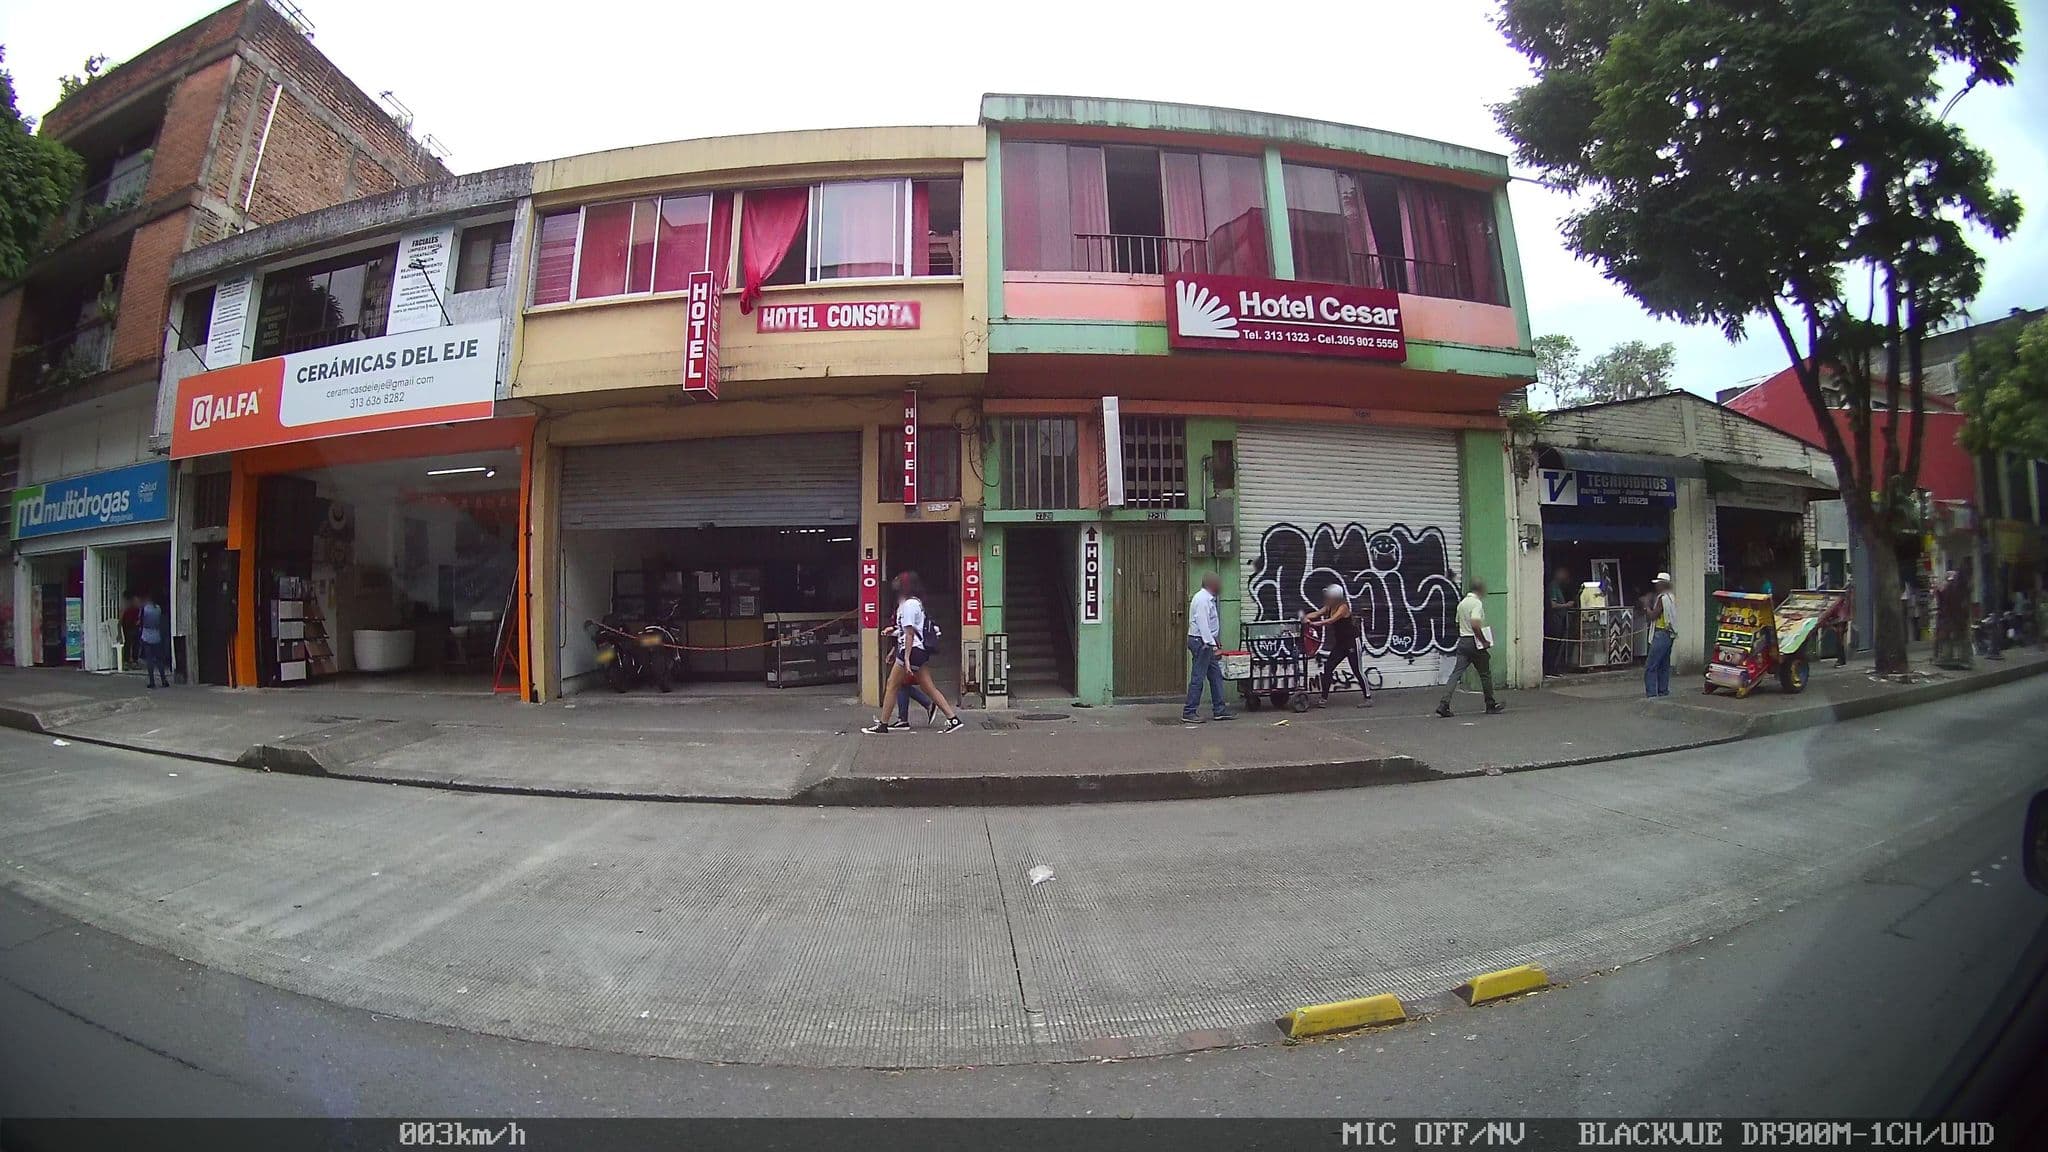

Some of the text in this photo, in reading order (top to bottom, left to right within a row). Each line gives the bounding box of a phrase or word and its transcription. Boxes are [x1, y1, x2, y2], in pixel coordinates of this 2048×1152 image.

[411, 236, 440, 247] FACIALES
[762, 303, 914, 330] HOTEL CONSOTA
[1238, 290, 1399, 327] Hotel Cesar
[687, 282, 708, 379] HOTEL
[1242, 329, 1262, 340] Tel.
[1264, 330, 1283, 341] 313
[1285, 332, 1310, 343] 1323
[1356, 337, 1375, 347] 902
[1376, 338, 1399, 349] 5556
[296, 338, 479, 384] CERÁMICAS DEL EJE
[212, 391, 259, 422] ALFA
[350, 397, 364, 409] 313
[383, 391, 406, 404] 8282
[904, 407, 915, 487] HOTEL
[44, 486, 130, 523] multidrogas
[966, 561, 979, 622] HOTEL
[1086, 545, 1098, 617] HOTEL
